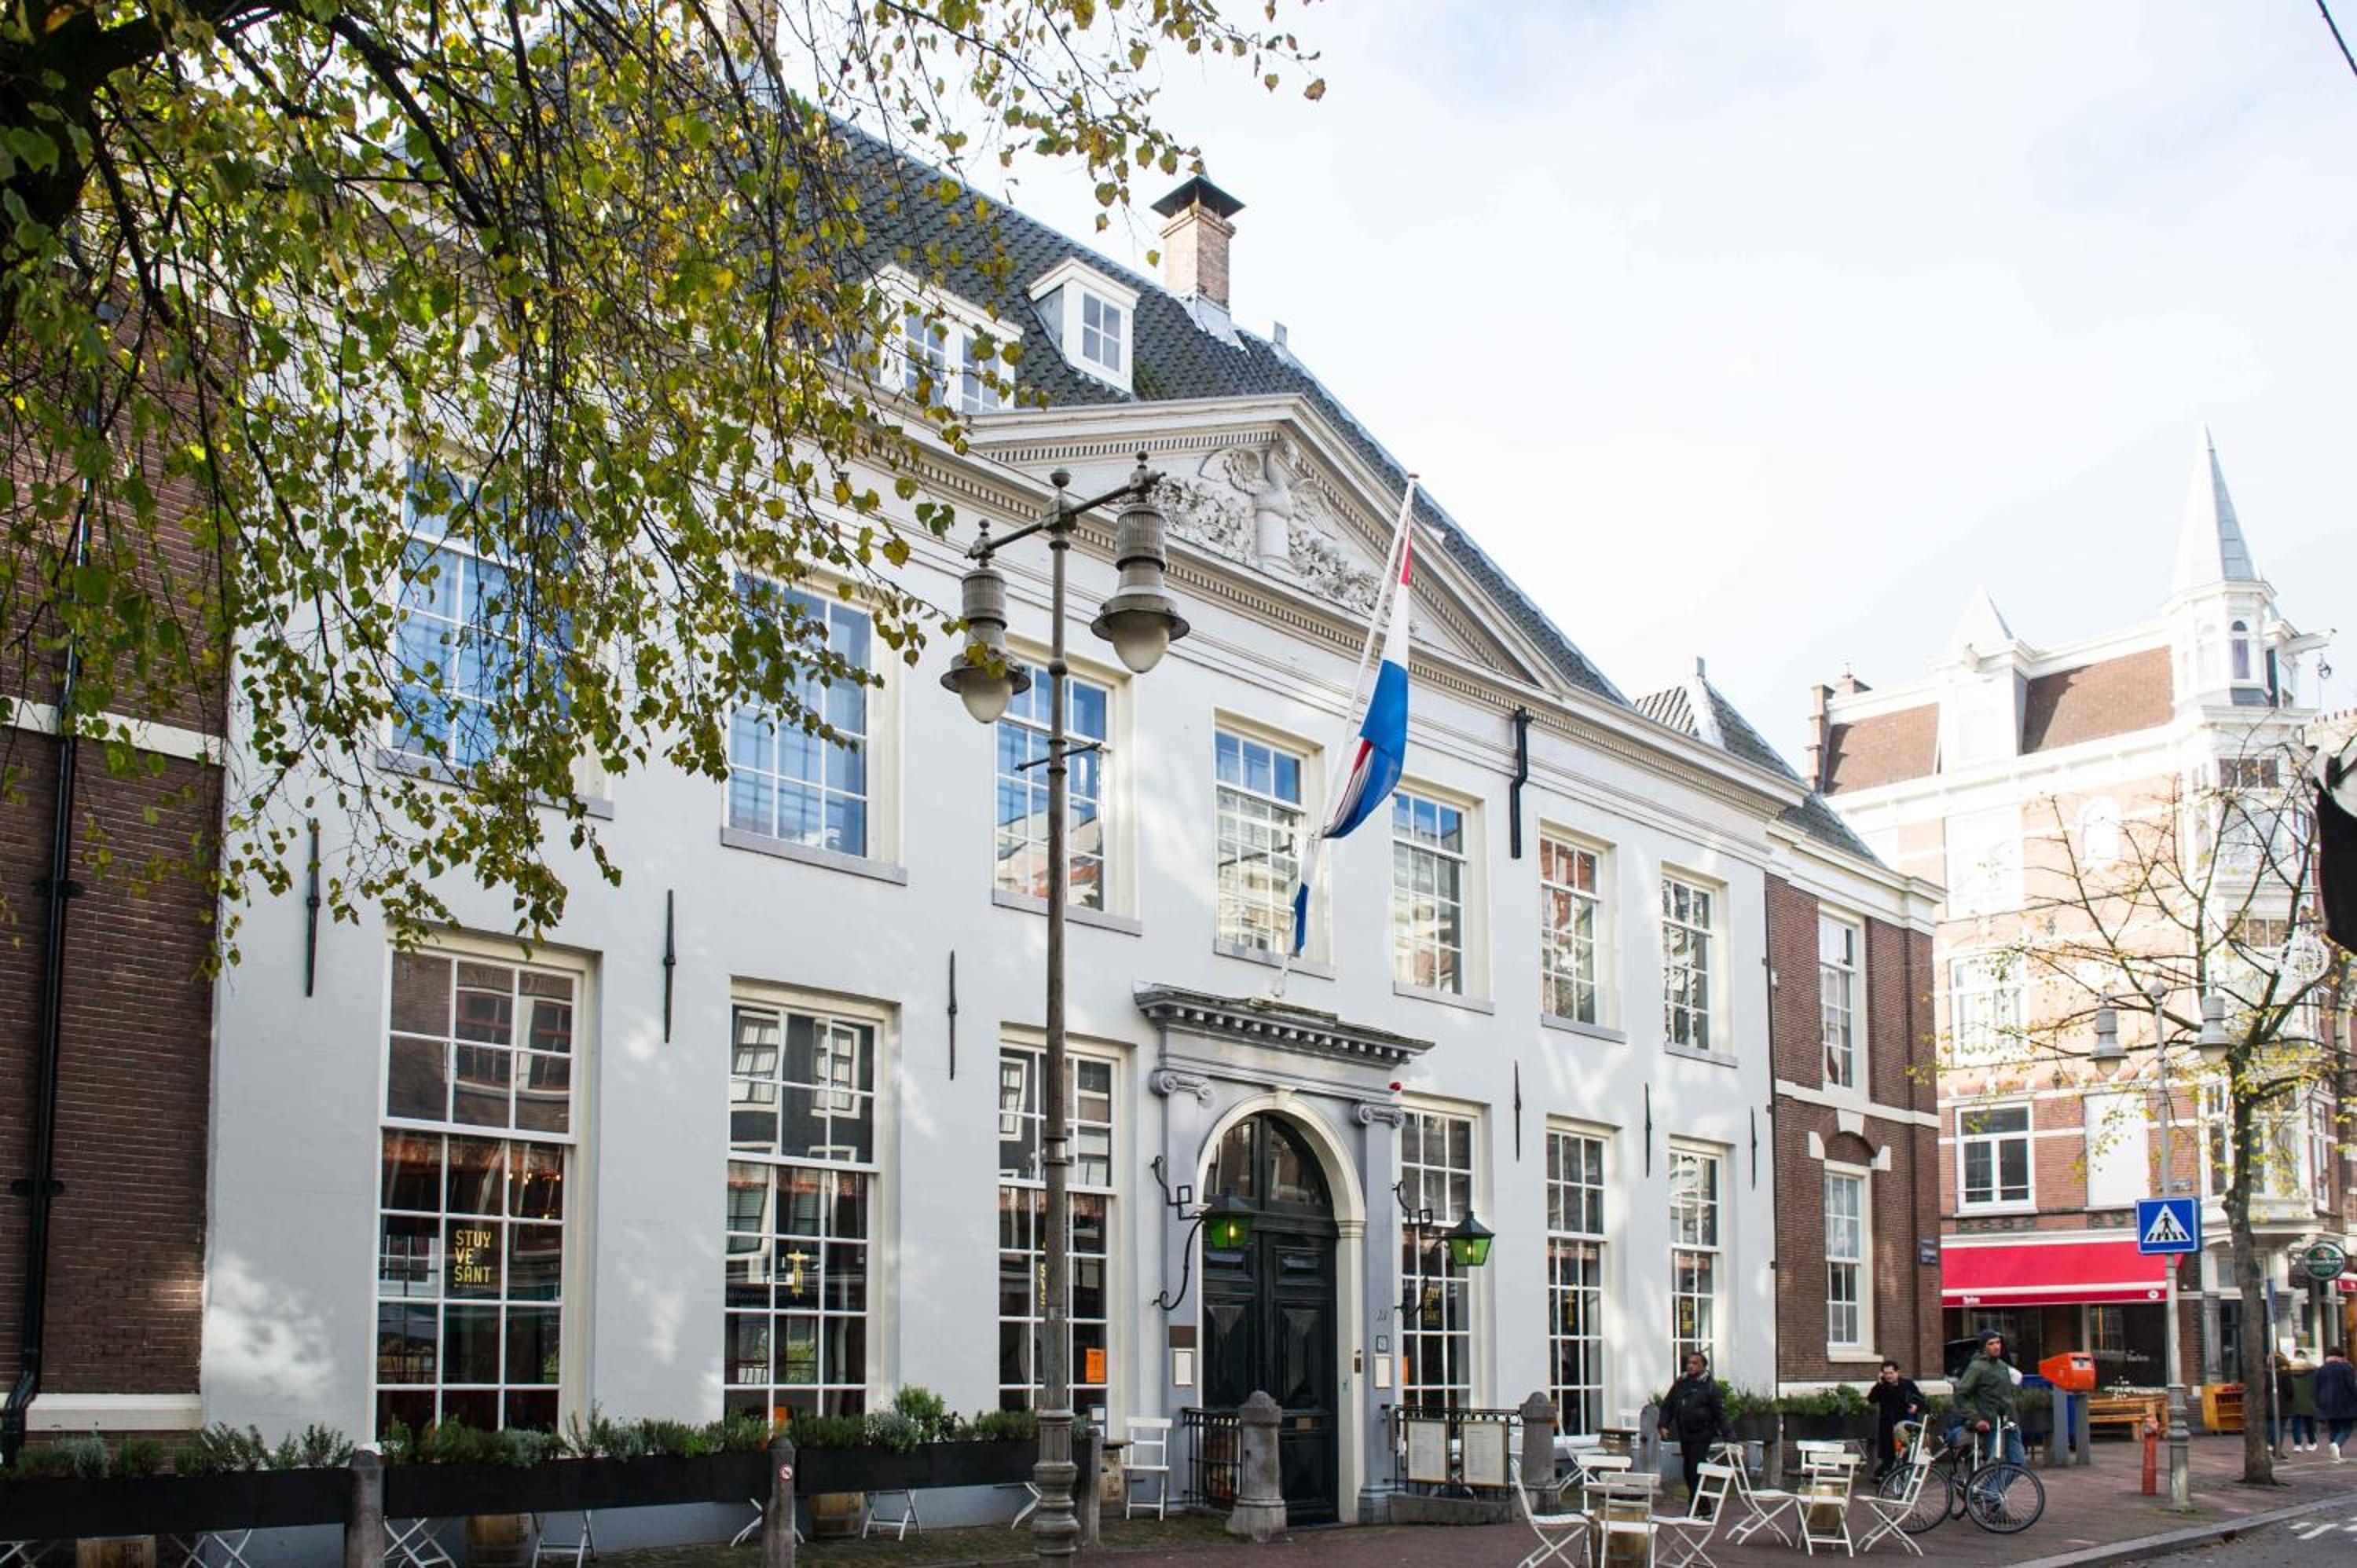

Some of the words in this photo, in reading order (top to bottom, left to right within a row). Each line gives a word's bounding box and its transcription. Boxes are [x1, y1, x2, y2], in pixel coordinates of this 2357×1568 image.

[455, 1229, 491, 1248] STUY
[455, 1247, 475, 1265] VE
[454, 1266, 491, 1283] SANT
